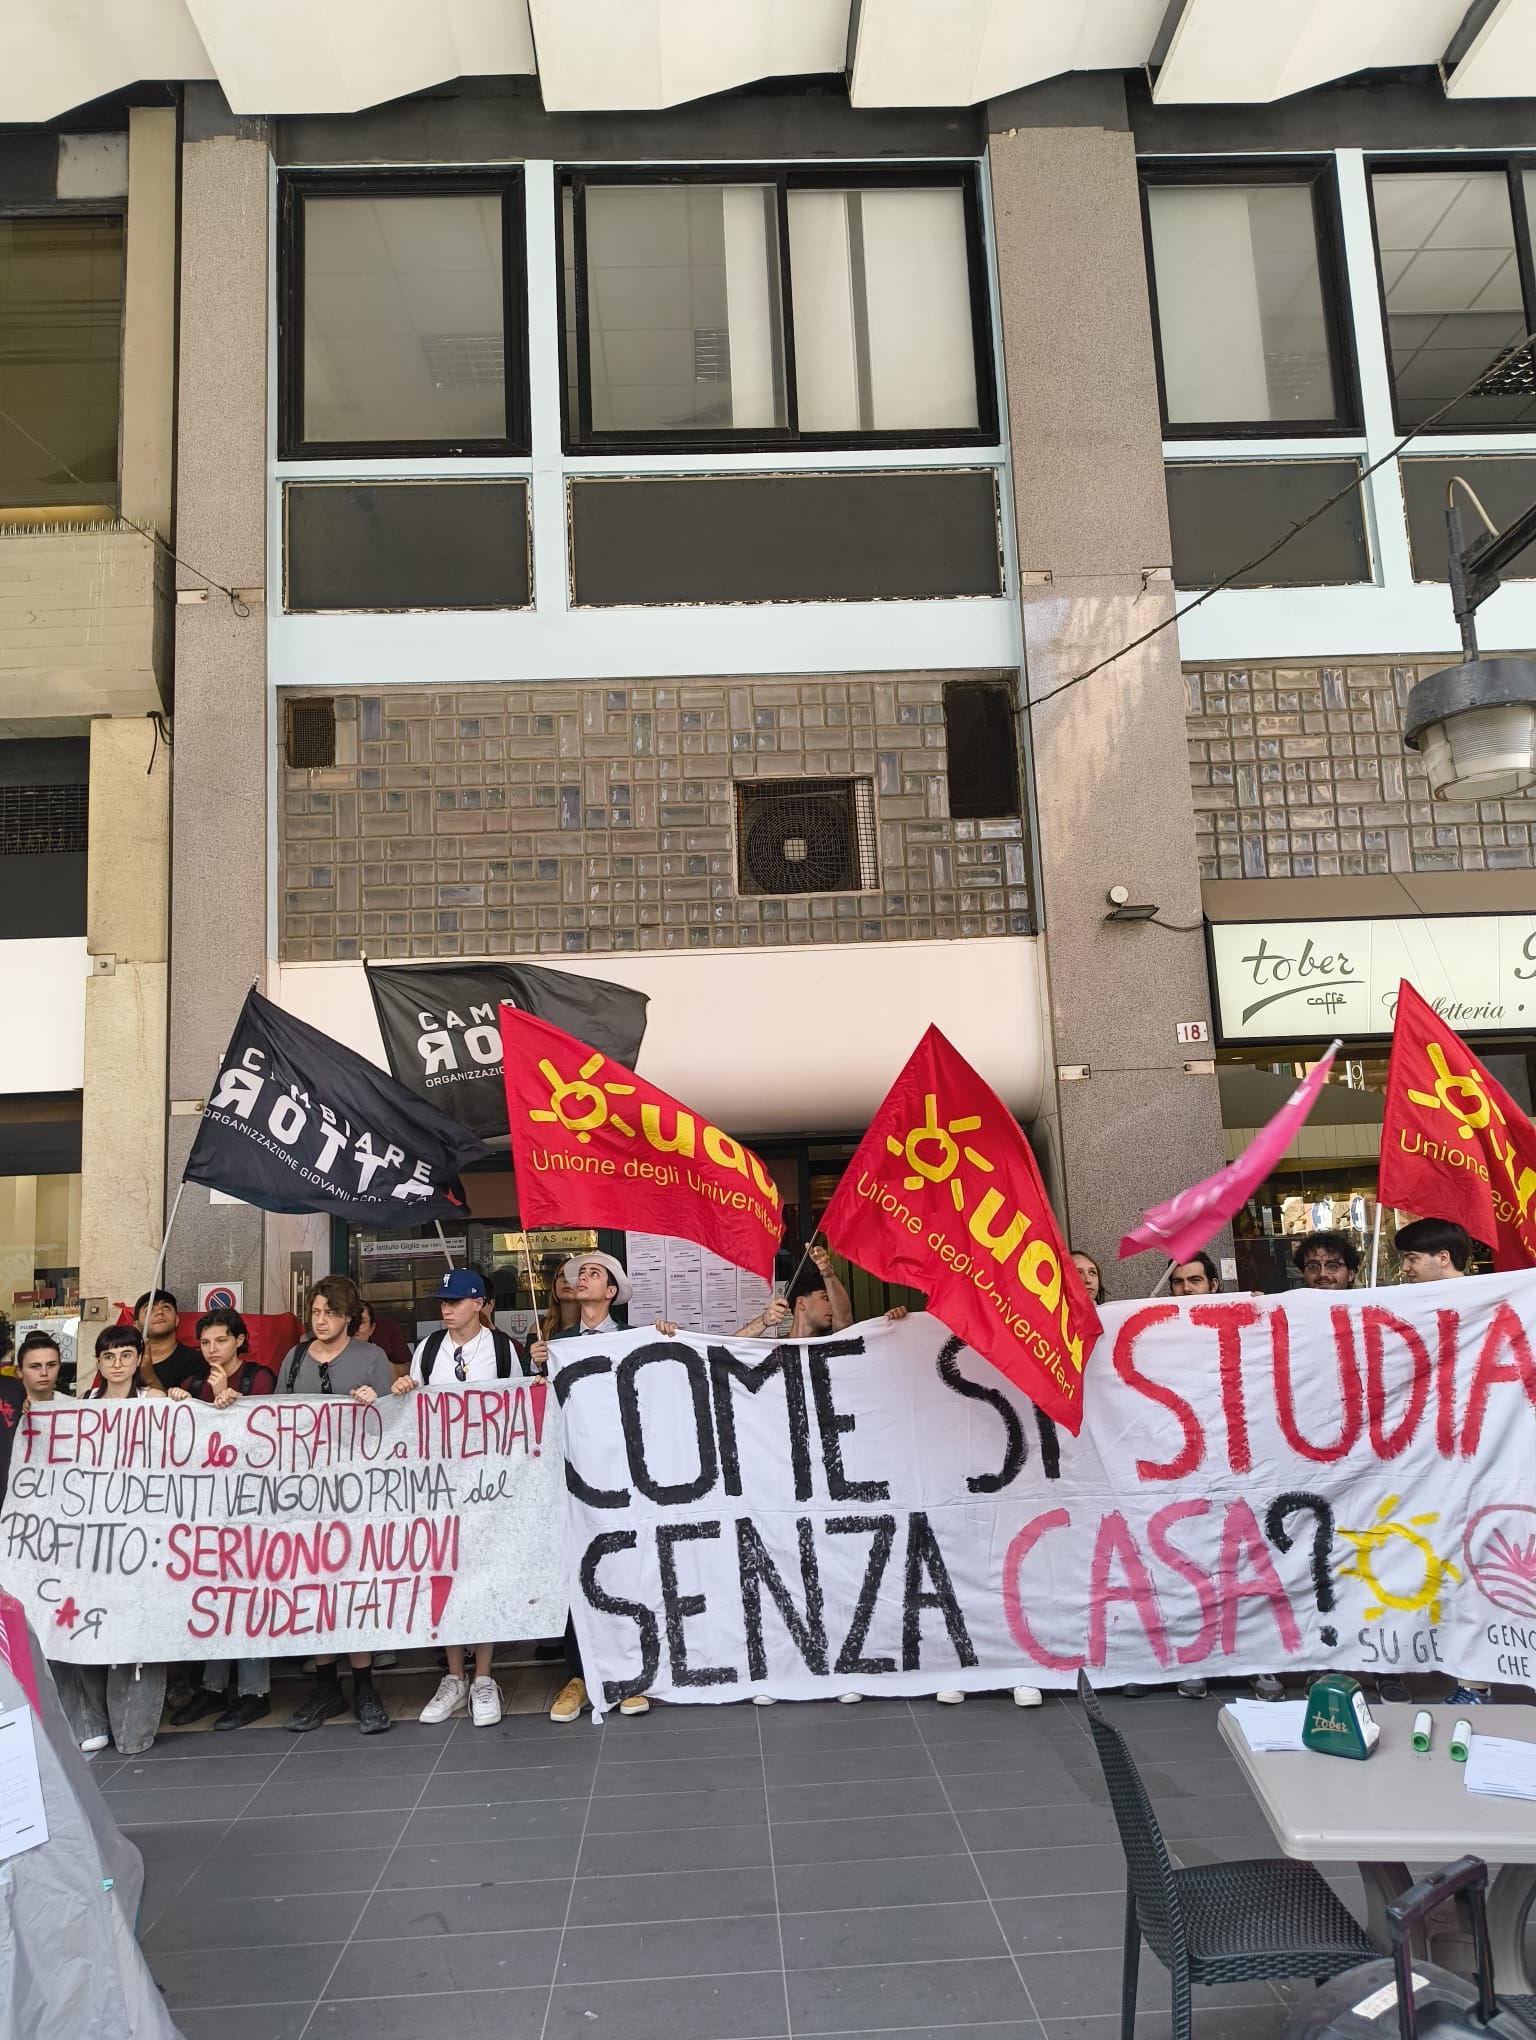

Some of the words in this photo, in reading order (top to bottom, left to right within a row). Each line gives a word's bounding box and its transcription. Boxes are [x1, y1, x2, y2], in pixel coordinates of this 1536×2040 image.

[1241, 938, 1355, 985] tober
[1184, 1024, 1201, 1041] 18
[204, 1108, 299, 1170] ORGANIZZAZIONE
[242, 1047, 432, 1183] CMBIARE
[533, 1149, 617, 1176] Unione
[624, 1158, 679, 1186] degli
[1400, 1129, 1489, 1182] Unione
[974, 1269, 1075, 1400] Universitari
[22, 1405, 195, 1470] FERMIAMO
[202, 1431, 238, 1468] lo
[245, 1403, 382, 1472] SFRATTO
[385, 1441, 408, 1460] a
[417, 1384, 547, 1461] IMPERIA!
[553, 1336, 890, 1508] COME
[12, 1467, 55, 1499] GLI
[61, 1468, 215, 1521] STUDENTI
[225, 1472, 363, 1515] VENGONO
[365, 1463, 457, 1514] PRIMA
[463, 1469, 513, 1503] del
[166, 1520, 351, 1581] SERVONO
[359, 1515, 460, 1572] NUOVI
[187, 1574, 453, 1640] STUDENTATI!
[581, 1511, 979, 1703] SENZA
[1498, 1653, 1530, 1678] CHE
